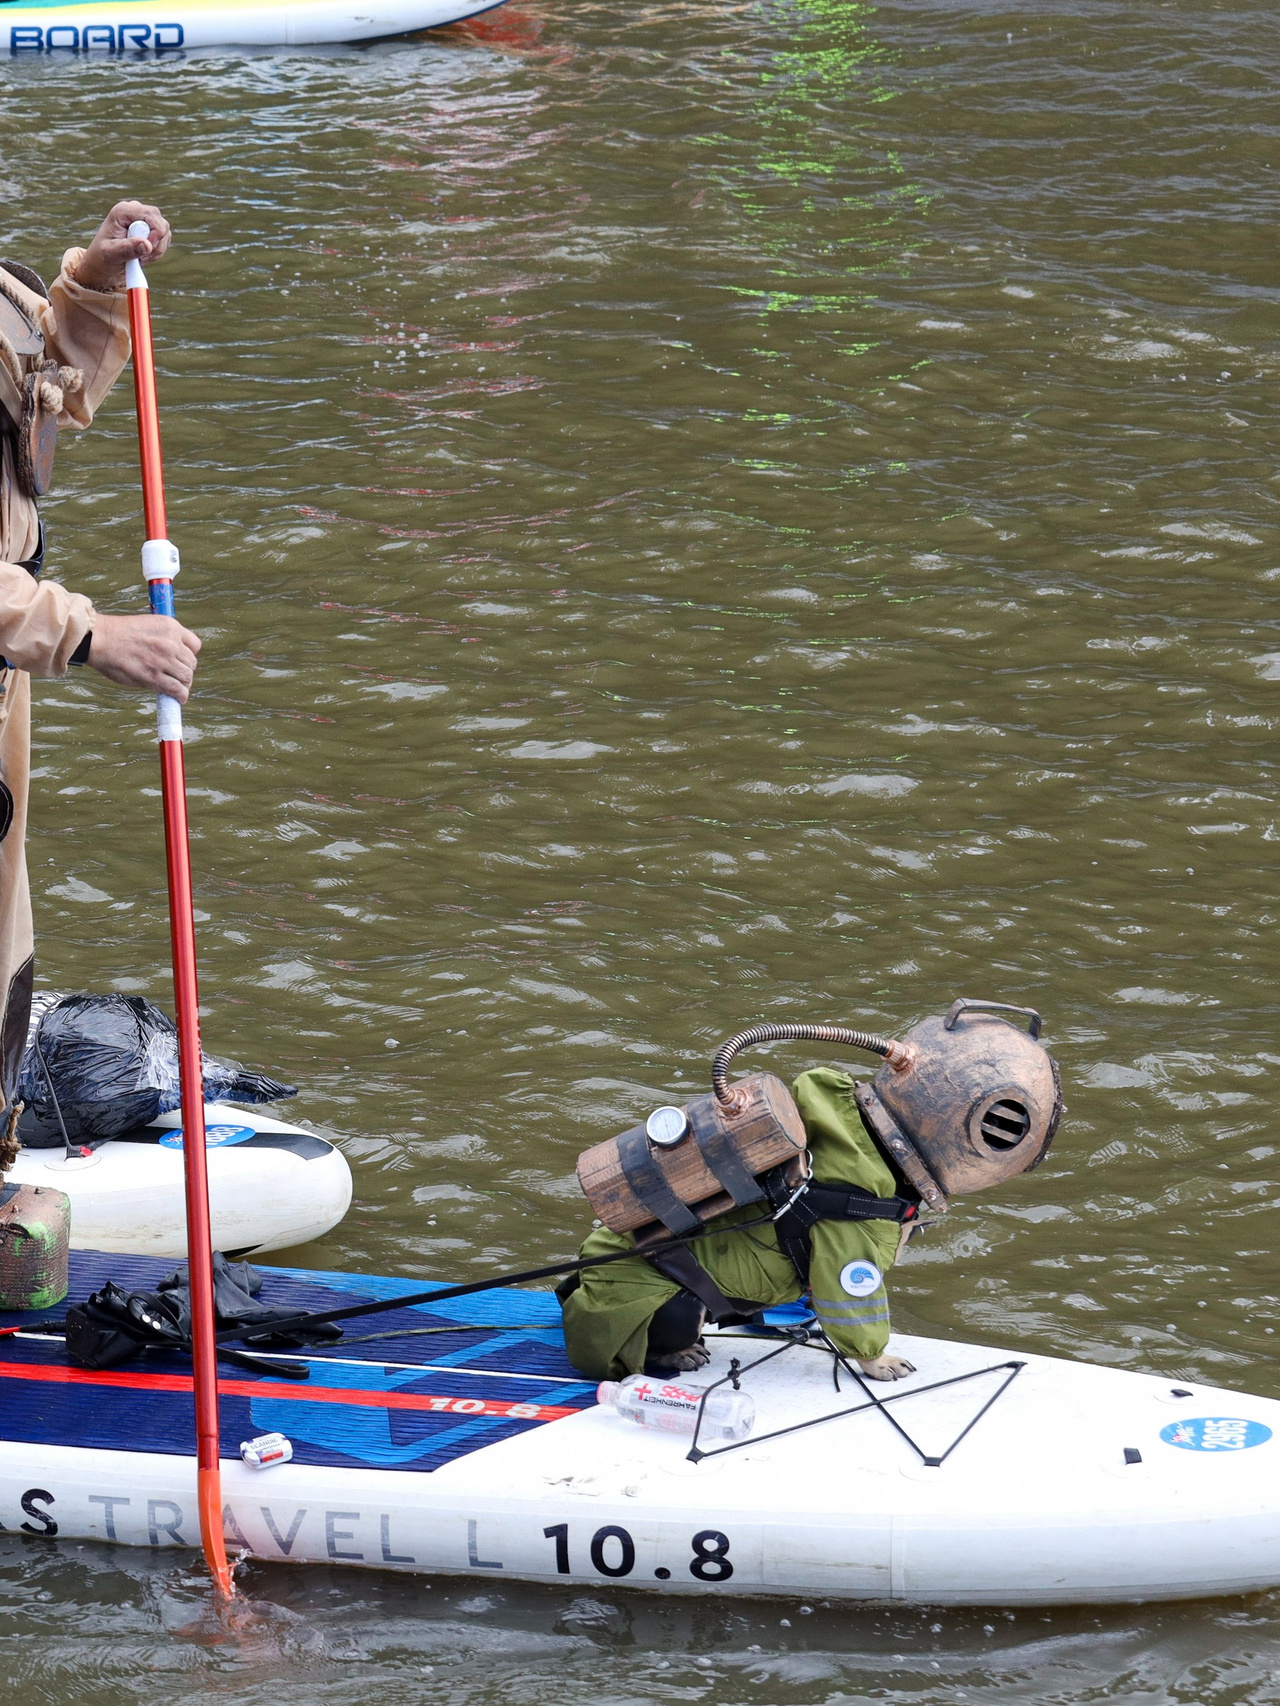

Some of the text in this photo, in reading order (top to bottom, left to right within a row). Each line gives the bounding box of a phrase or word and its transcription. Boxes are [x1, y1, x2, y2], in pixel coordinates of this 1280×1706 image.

[11, 23, 184, 51] BOARD
[429, 1397, 542, 1418] 10.8
[643, 1395, 696, 1411] FAHRENHEIT
[1200, 1420, 1249, 1449] 2965
[88, 1494, 416, 1564] TRAVEL
[467, 1518, 504, 1569] L
[542, 1523, 735, 1582] 10.8
